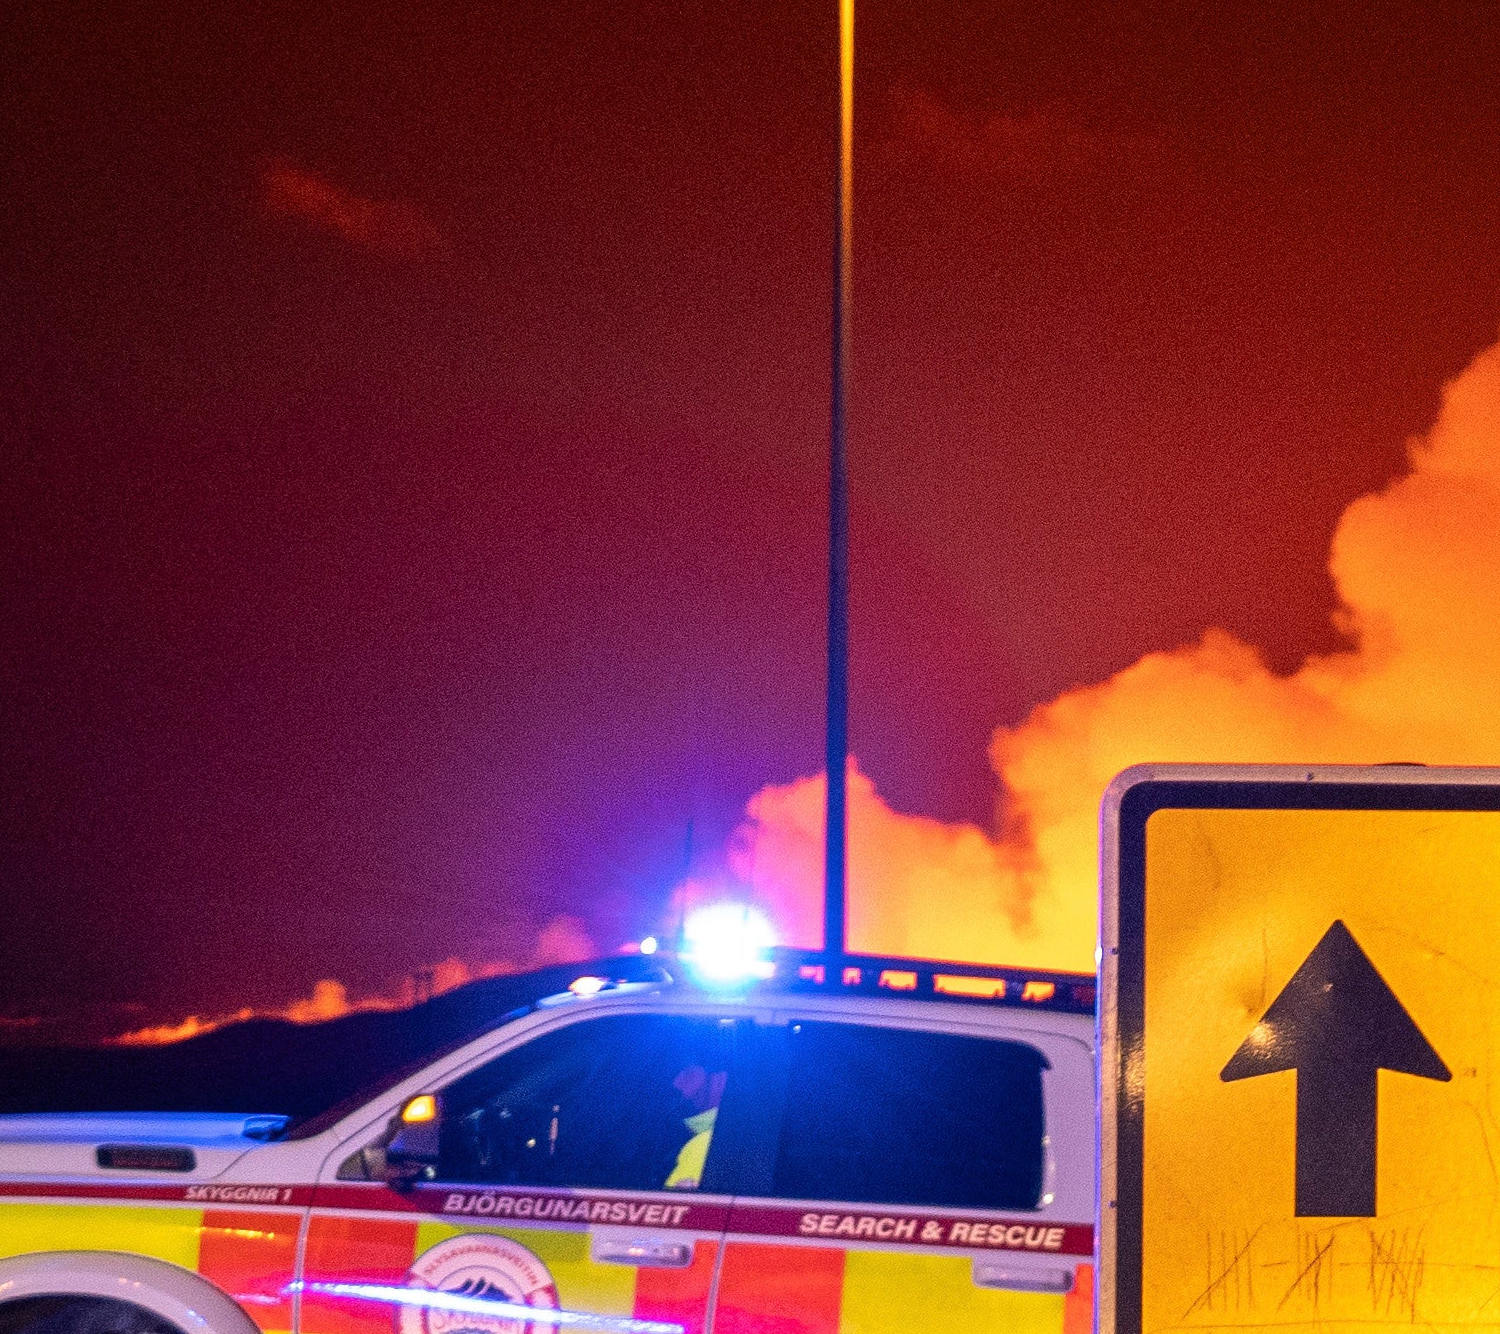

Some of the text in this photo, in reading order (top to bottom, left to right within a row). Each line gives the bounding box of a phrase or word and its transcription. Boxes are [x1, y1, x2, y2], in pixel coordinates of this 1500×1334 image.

[444, 1191, 688, 1224] BJÖRGUNARSVEIT
[800, 1213, 1065, 1249] SEARCH & RESCUE
